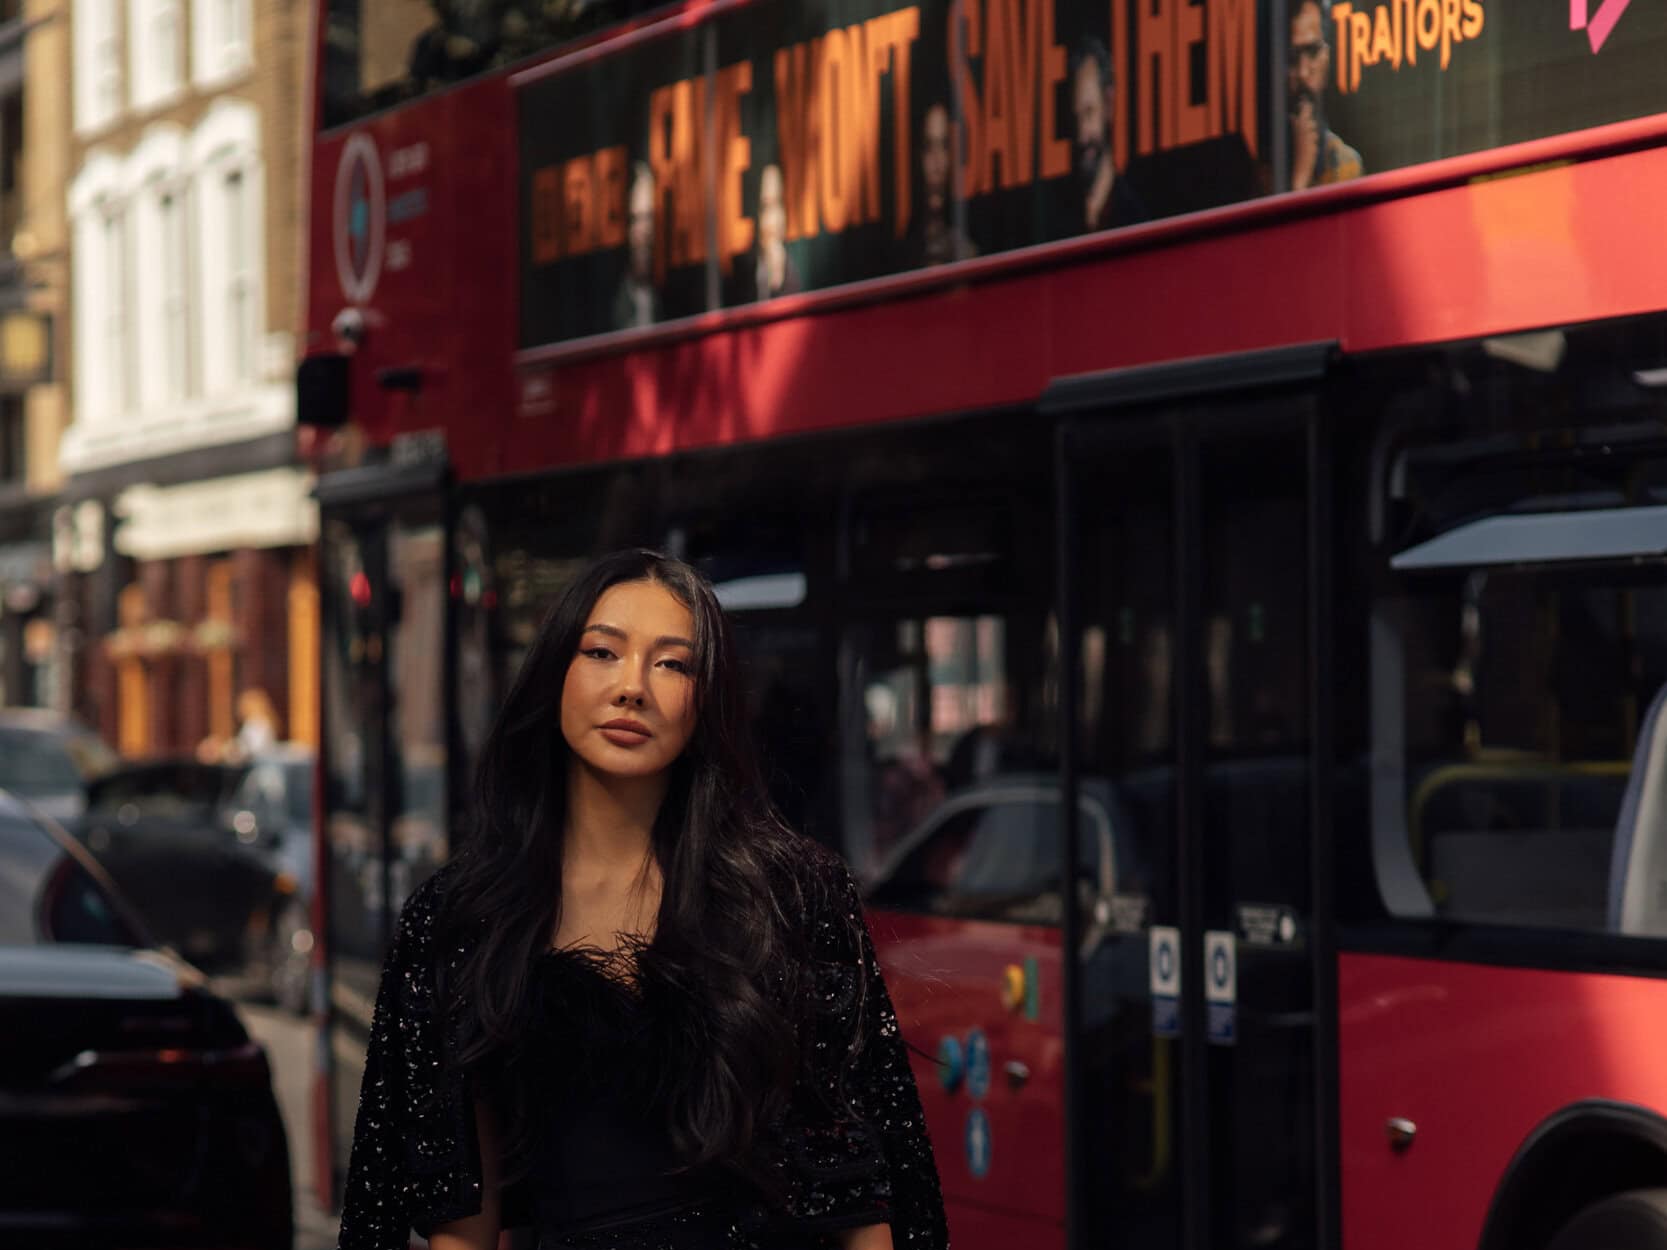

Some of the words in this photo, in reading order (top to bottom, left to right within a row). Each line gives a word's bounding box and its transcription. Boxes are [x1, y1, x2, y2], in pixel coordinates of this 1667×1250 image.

[774, 6, 919, 239] WON'T
[946, 0, 1072, 198] SAVE
[1331, 0, 1485, 95] TRAITORS
